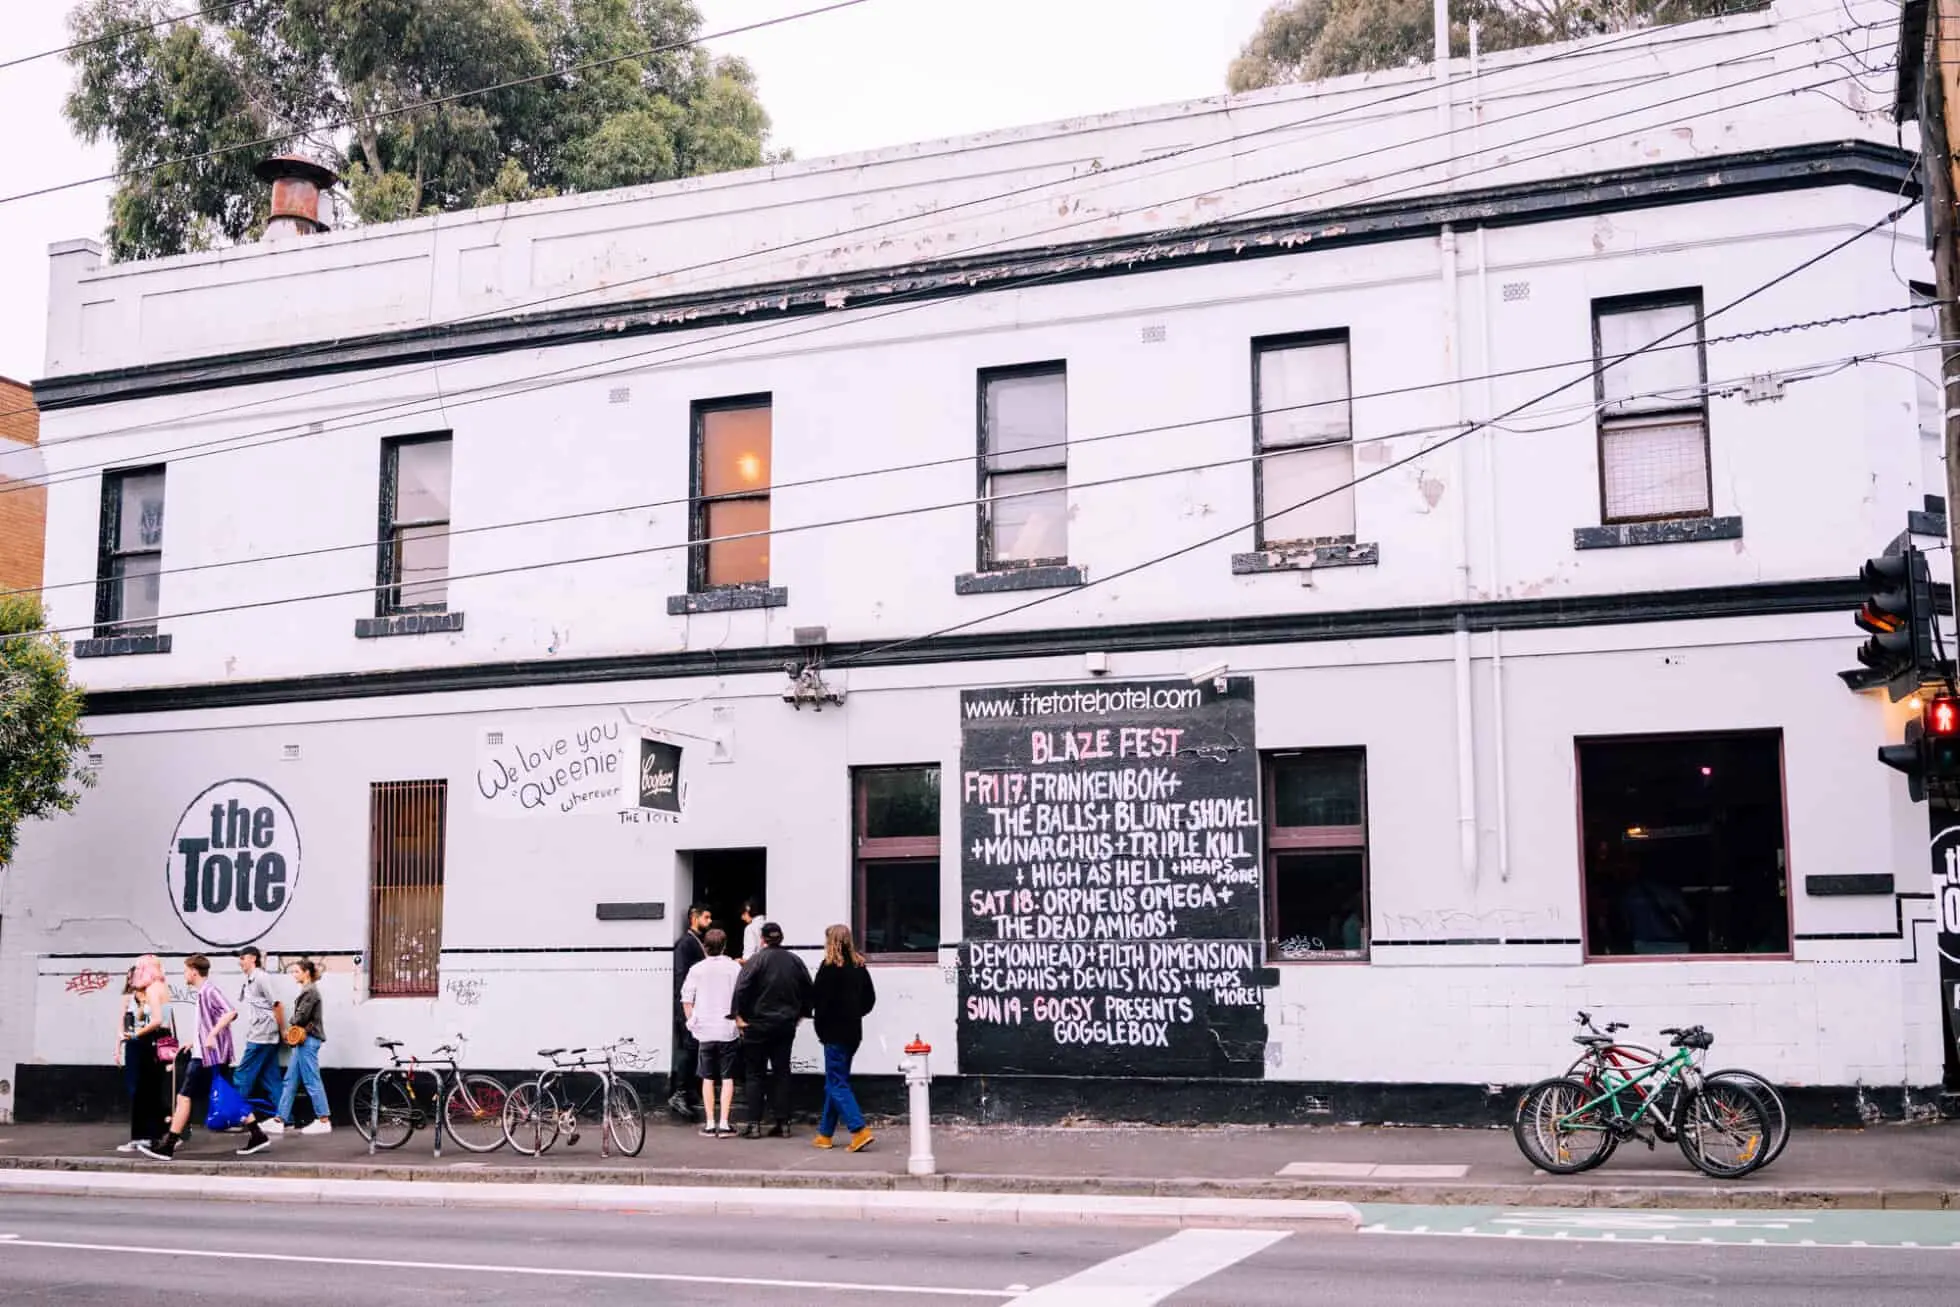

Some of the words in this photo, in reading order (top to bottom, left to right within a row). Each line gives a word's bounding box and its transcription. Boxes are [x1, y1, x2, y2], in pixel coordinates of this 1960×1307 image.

[477, 759, 519, 799] We
[516, 739, 568, 773] love
[577, 722, 618, 752] you
[1031, 729, 1114, 764] BLAZE
[1120, 728, 1184, 758] FEST
[560, 787, 622, 813] wherever
[965, 770, 999, 805] FRI
[210, 799, 275, 849] the
[617, 810, 640, 825] THE
[987, 803, 1033, 837] THE
[1115, 800, 1186, 832] BLUNT
[1186, 796, 1259, 831] SHOVEL
[1206, 830, 1253, 859] KILL
[178, 837, 287, 914] Tote
[1031, 862, 1081, 888] HIGH
[1086, 862, 1112, 887] AS
[1115, 859, 1171, 887] HELL
[970, 889, 1011, 916] SAT
[1043, 886, 1136, 915] ORPHEUS
[991, 915, 1034, 940] THE
[1037, 914, 1090, 940] DEAD
[1149, 942, 1254, 971] DIMENSION
[1073, 967, 1134, 992] DEVILS
[1138, 967, 1182, 993] KISS
[1195, 970, 1241, 991] HEAPS
[966, 994, 1001, 1024] SUN
[1033, 995, 1095, 1021] GOCSY
[1105, 995, 1194, 1023] PRESENTS
[1213, 985, 1262, 1010] MORE!
[1054, 1019, 1169, 1047] GOGGLEBOX
